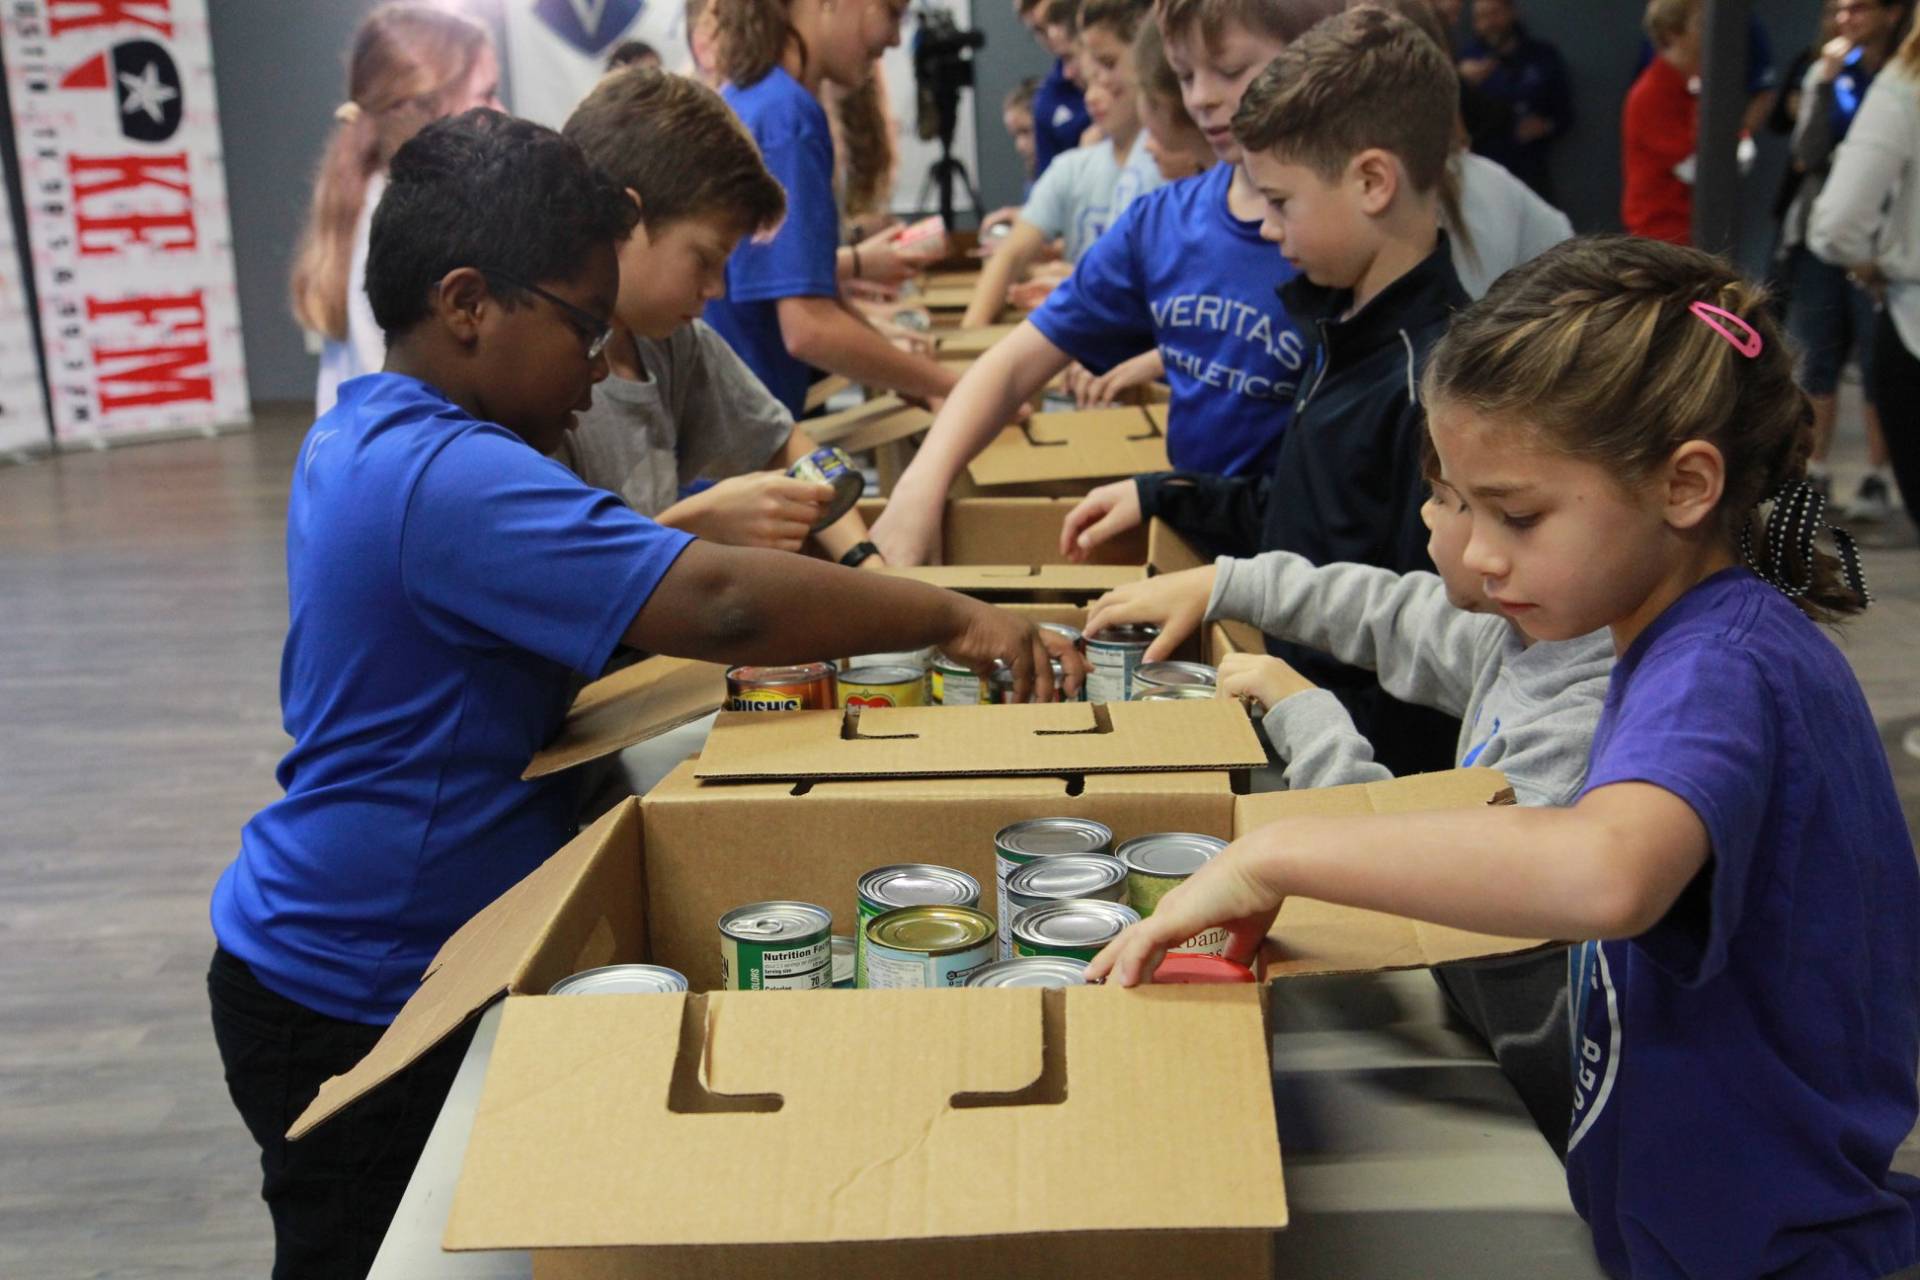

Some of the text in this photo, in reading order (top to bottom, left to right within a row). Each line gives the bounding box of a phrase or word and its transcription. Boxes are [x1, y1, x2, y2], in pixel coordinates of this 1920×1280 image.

[86, 290, 213, 413] FM
[1150, 294, 1303, 370] VERITAS
[764, 949, 811, 961] Nutrition
[810, 975, 820, 987] 70
